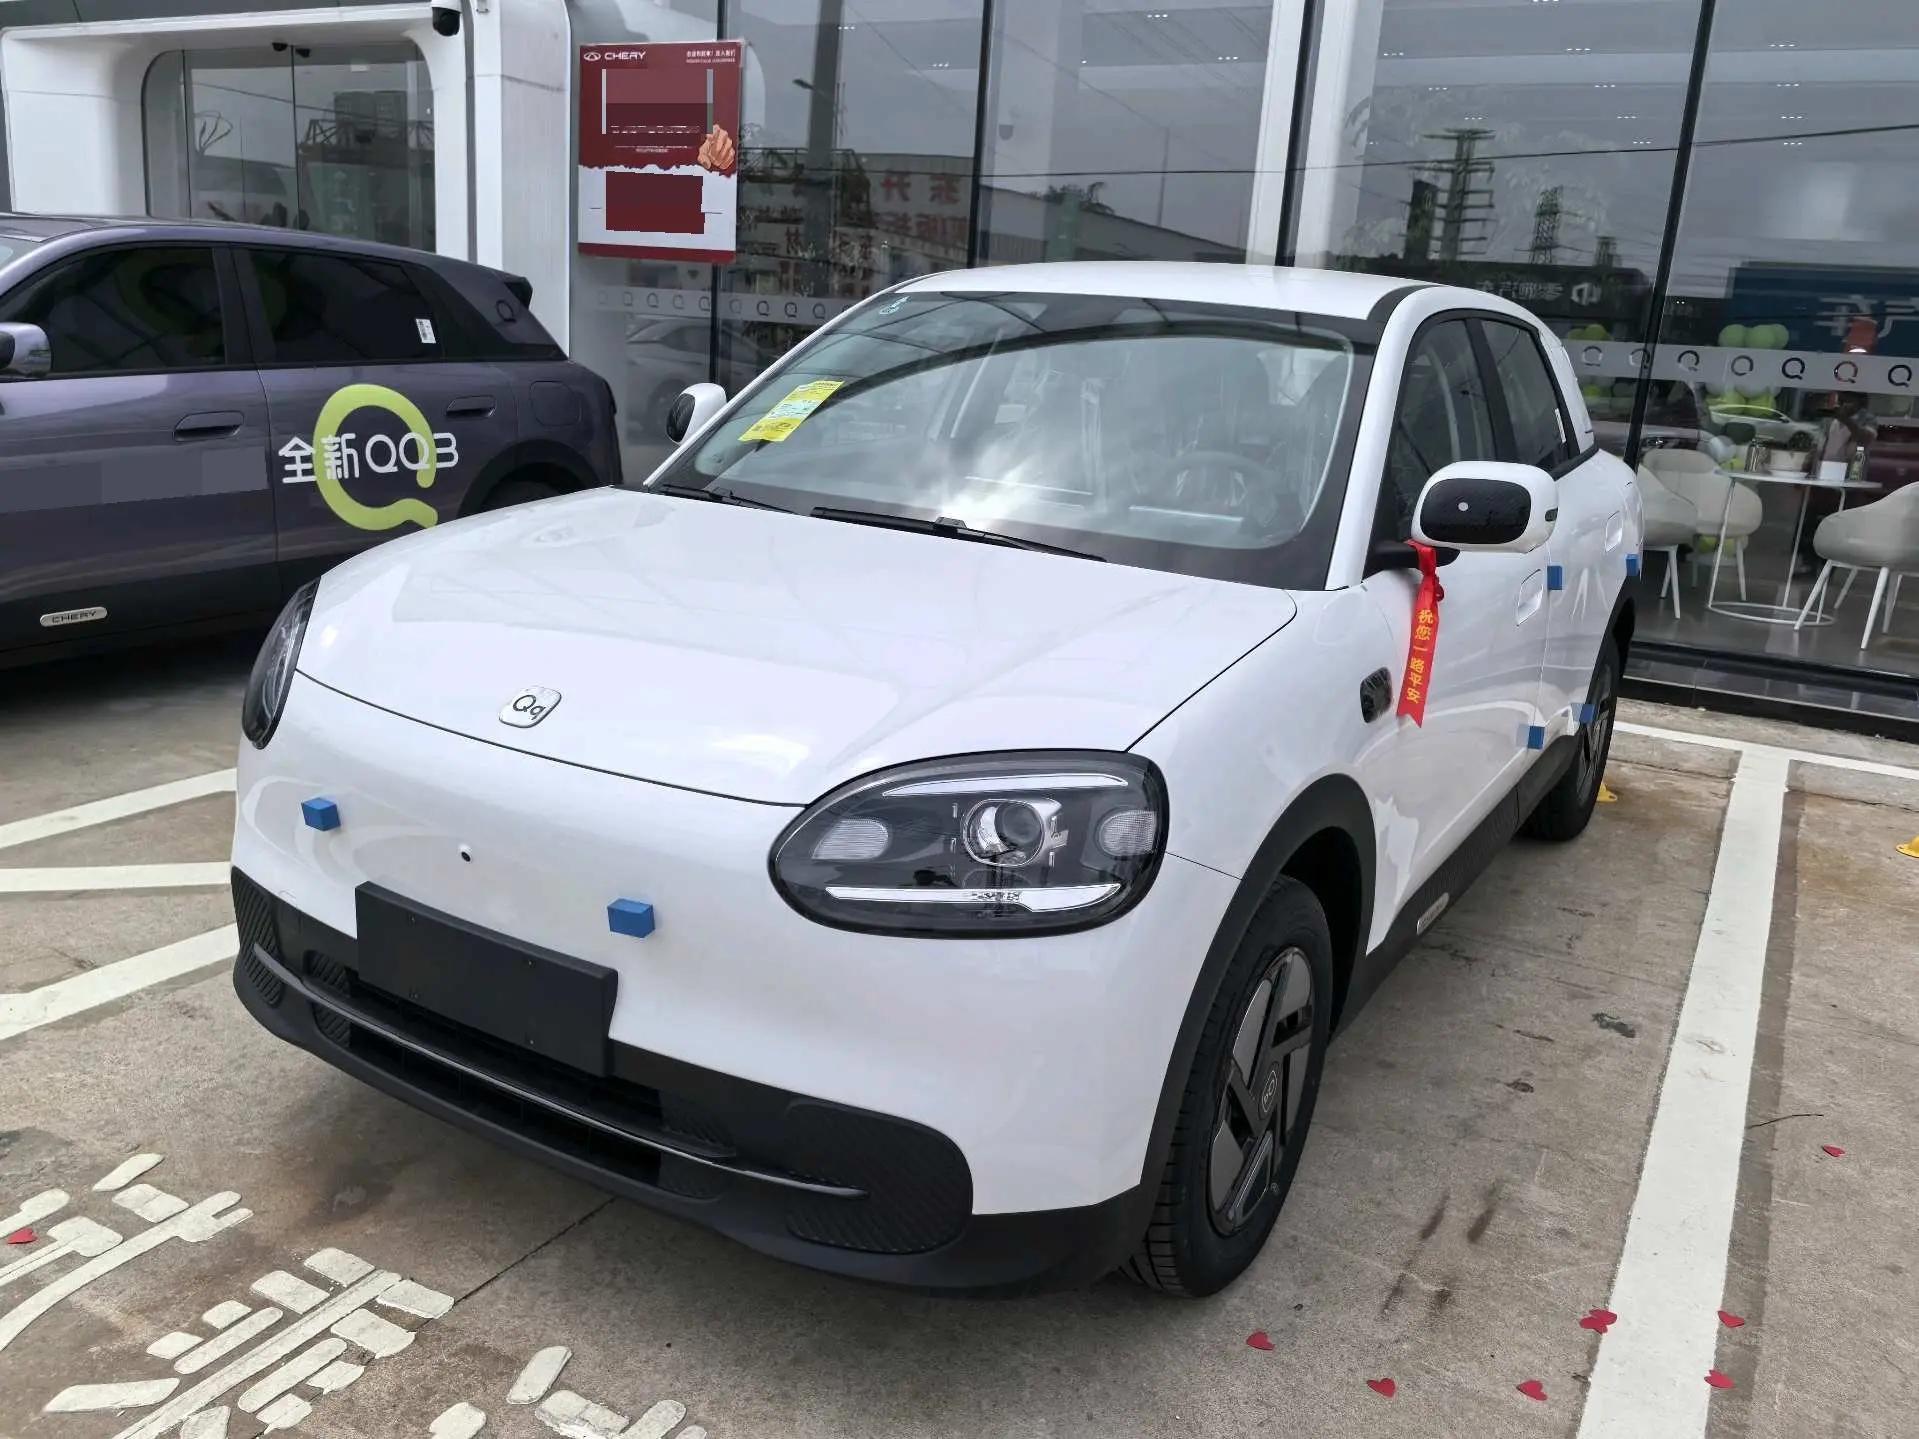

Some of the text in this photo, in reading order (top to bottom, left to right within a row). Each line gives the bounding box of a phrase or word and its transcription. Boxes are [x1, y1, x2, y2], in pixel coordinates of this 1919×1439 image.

[604, 51, 647, 60] CHERY
[52, 610, 97, 624] CHERY
[1406, 609, 1435, 704] 祝您一路平安
